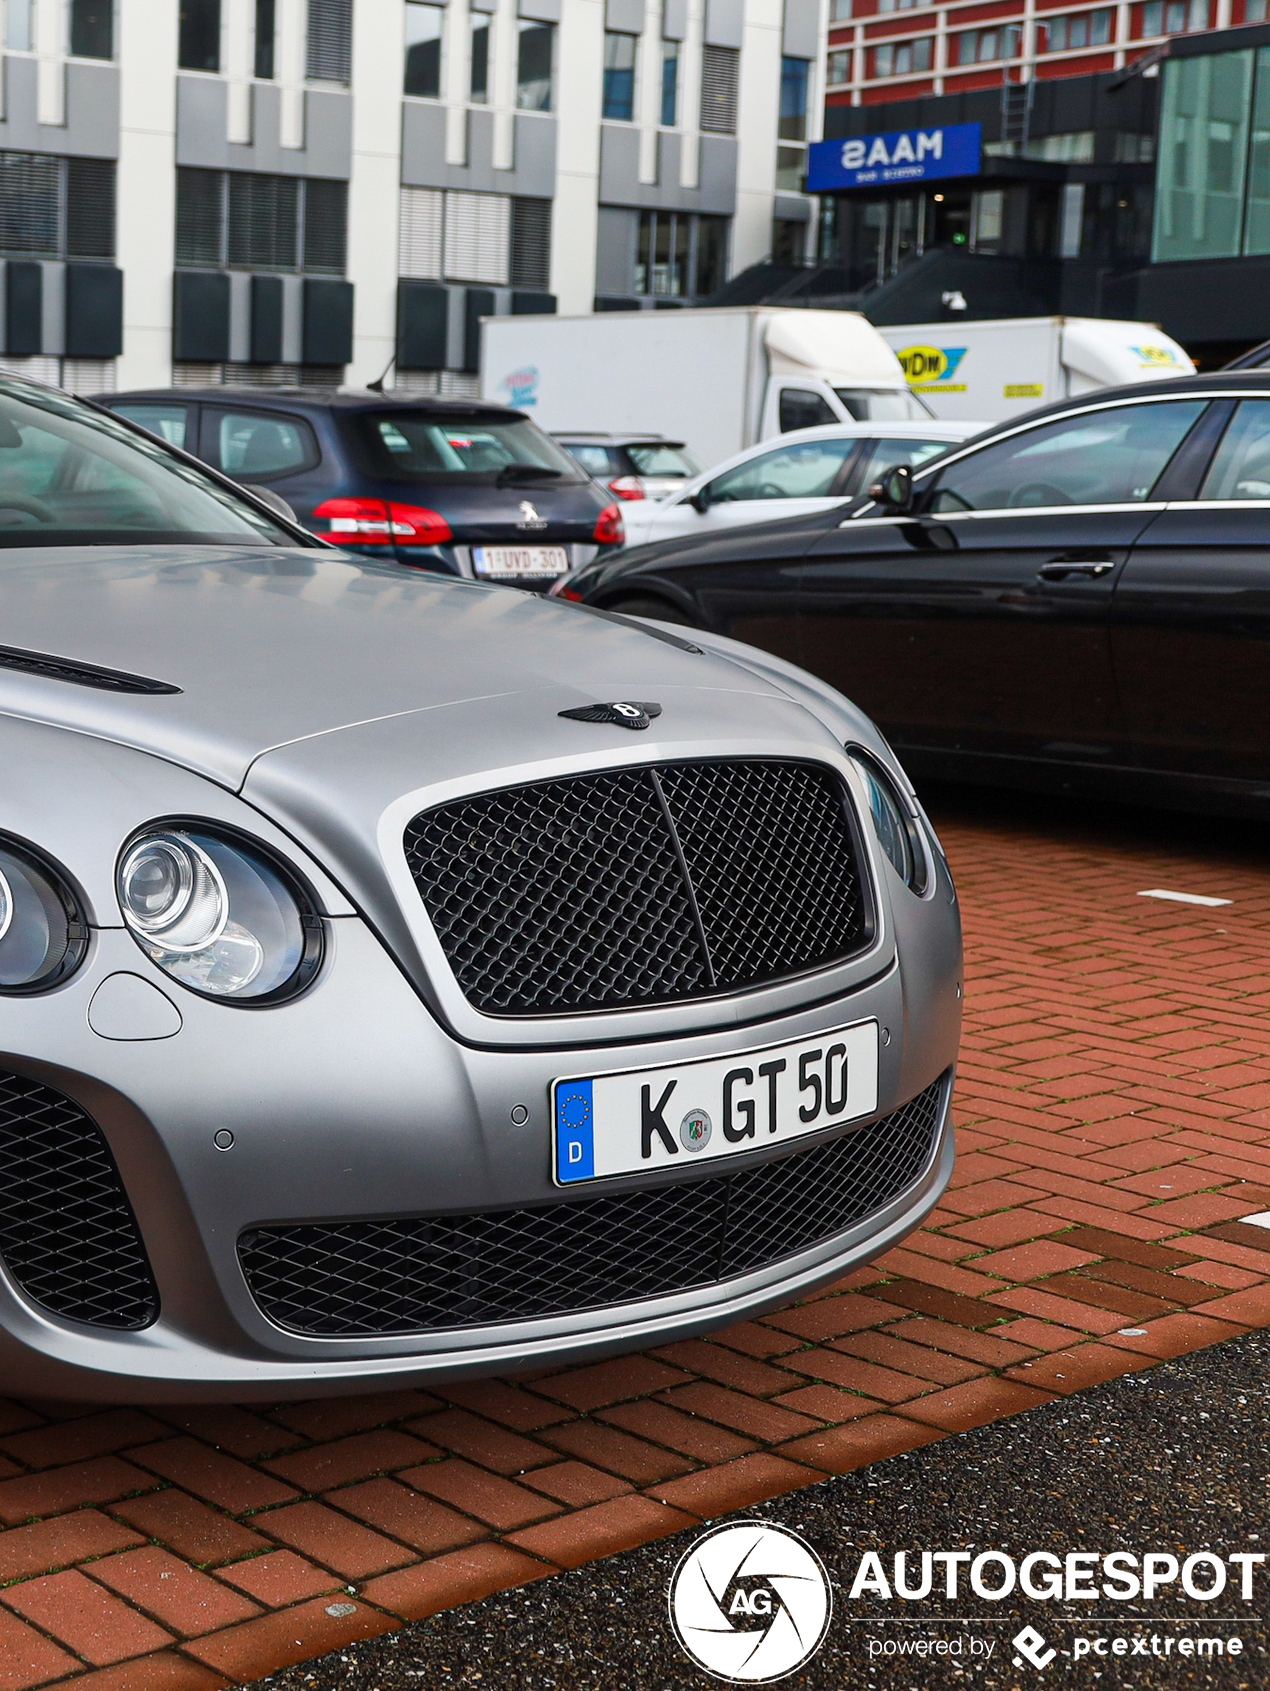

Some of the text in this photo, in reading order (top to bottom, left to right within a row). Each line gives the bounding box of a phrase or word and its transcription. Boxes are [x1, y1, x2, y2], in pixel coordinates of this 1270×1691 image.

[640, 1079, 679, 1159] K
[722, 1058, 787, 1143] GT
[798, 1042, 848, 1124] 50
[568, 1140, 583, 1164] D
